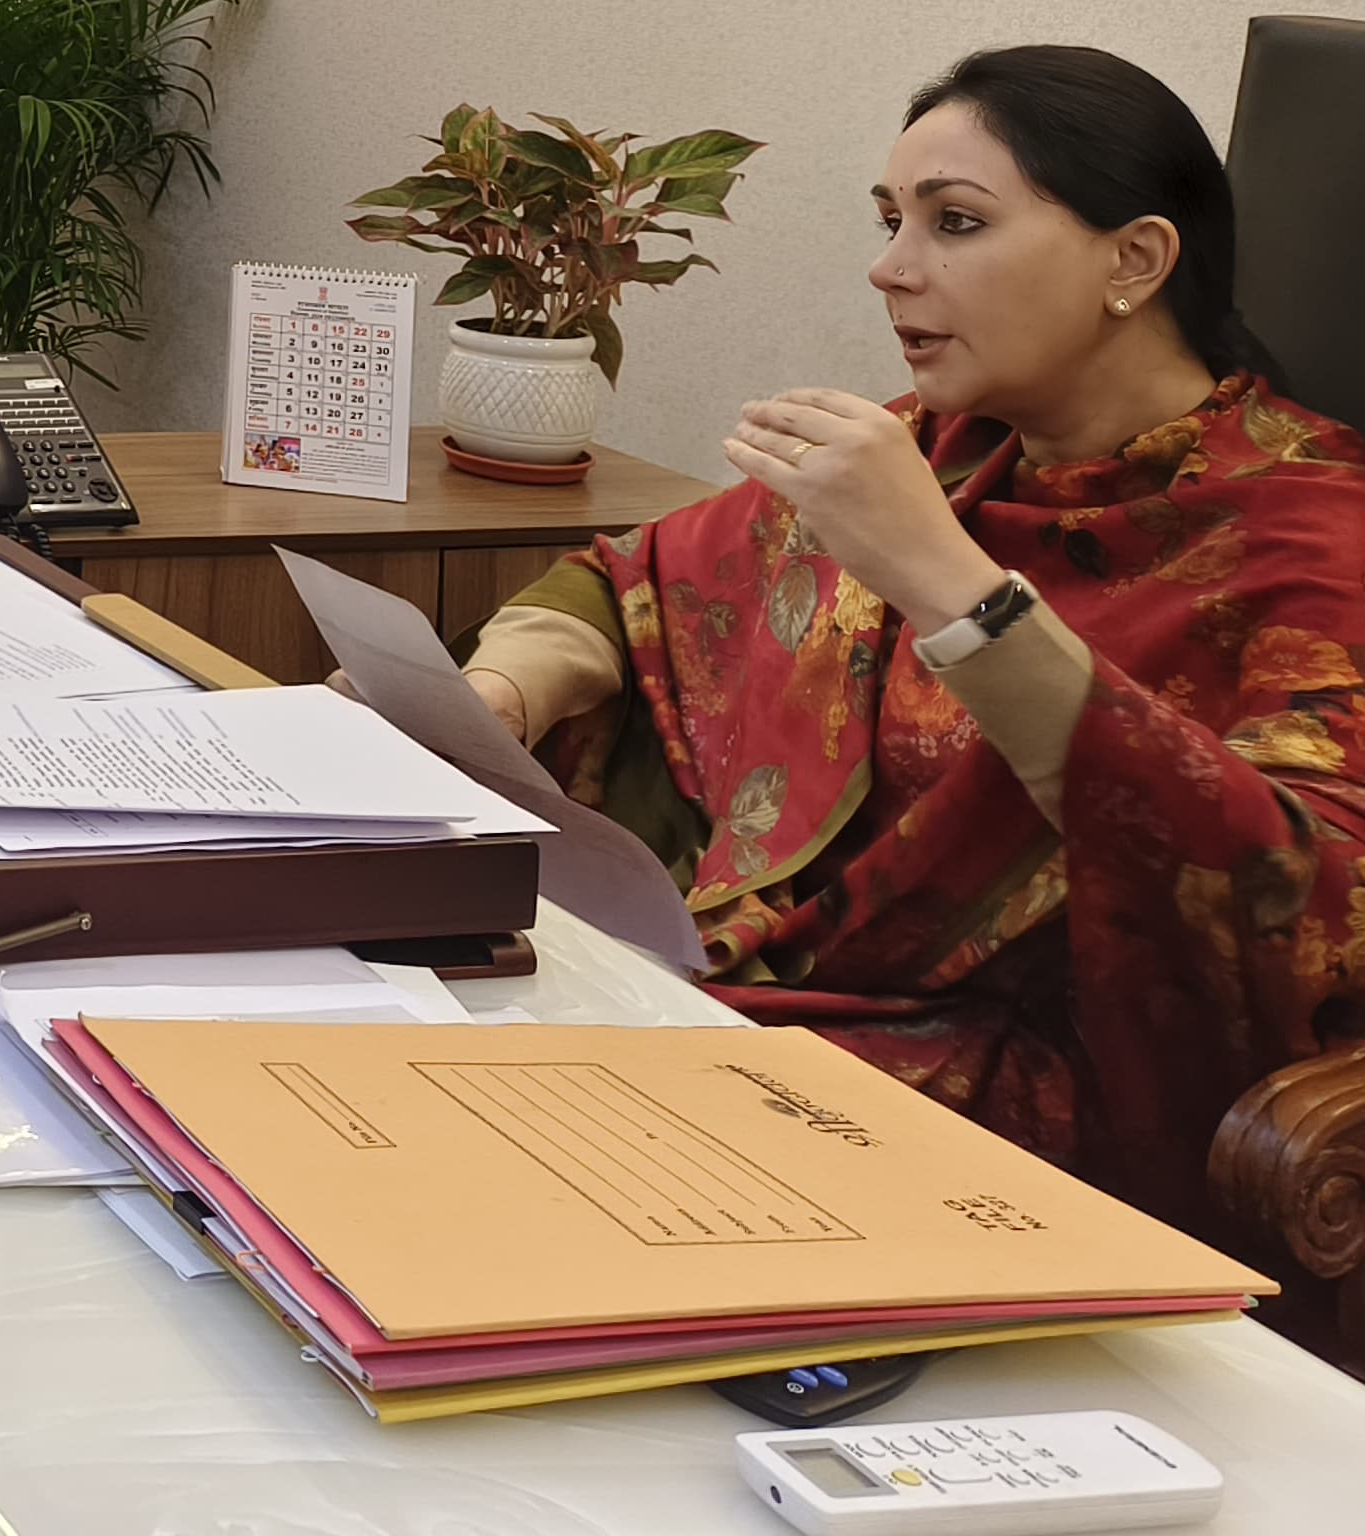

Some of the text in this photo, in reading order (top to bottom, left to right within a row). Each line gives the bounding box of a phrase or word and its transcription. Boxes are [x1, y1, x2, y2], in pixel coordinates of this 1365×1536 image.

[312, 323, 318, 331] 8
[332, 326, 345, 334] 15
[354, 328, 367, 336] 22
[377, 330, 390, 338] 29
[289, 338, 295, 346] 2
[377, 347, 389, 355] 30
[330, 376, 342, 384] 18
[352, 378, 365, 386] 25
[287, 388, 292, 396] 5
[307, 390, 318, 398] 12
[330, 393, 341, 401] 19
[351, 395, 364, 403] 26
[306, 407, 317, 415] 13
[328, 410, 341, 418] 20
[350, 412, 363, 420] 27
[305, 424, 317, 432] 14
[327, 426, 339, 434] 21
[349, 429, 362, 437] 28
[943, 1199, 996, 1229] TAG
[962, 1199, 1025, 1230] FILE
